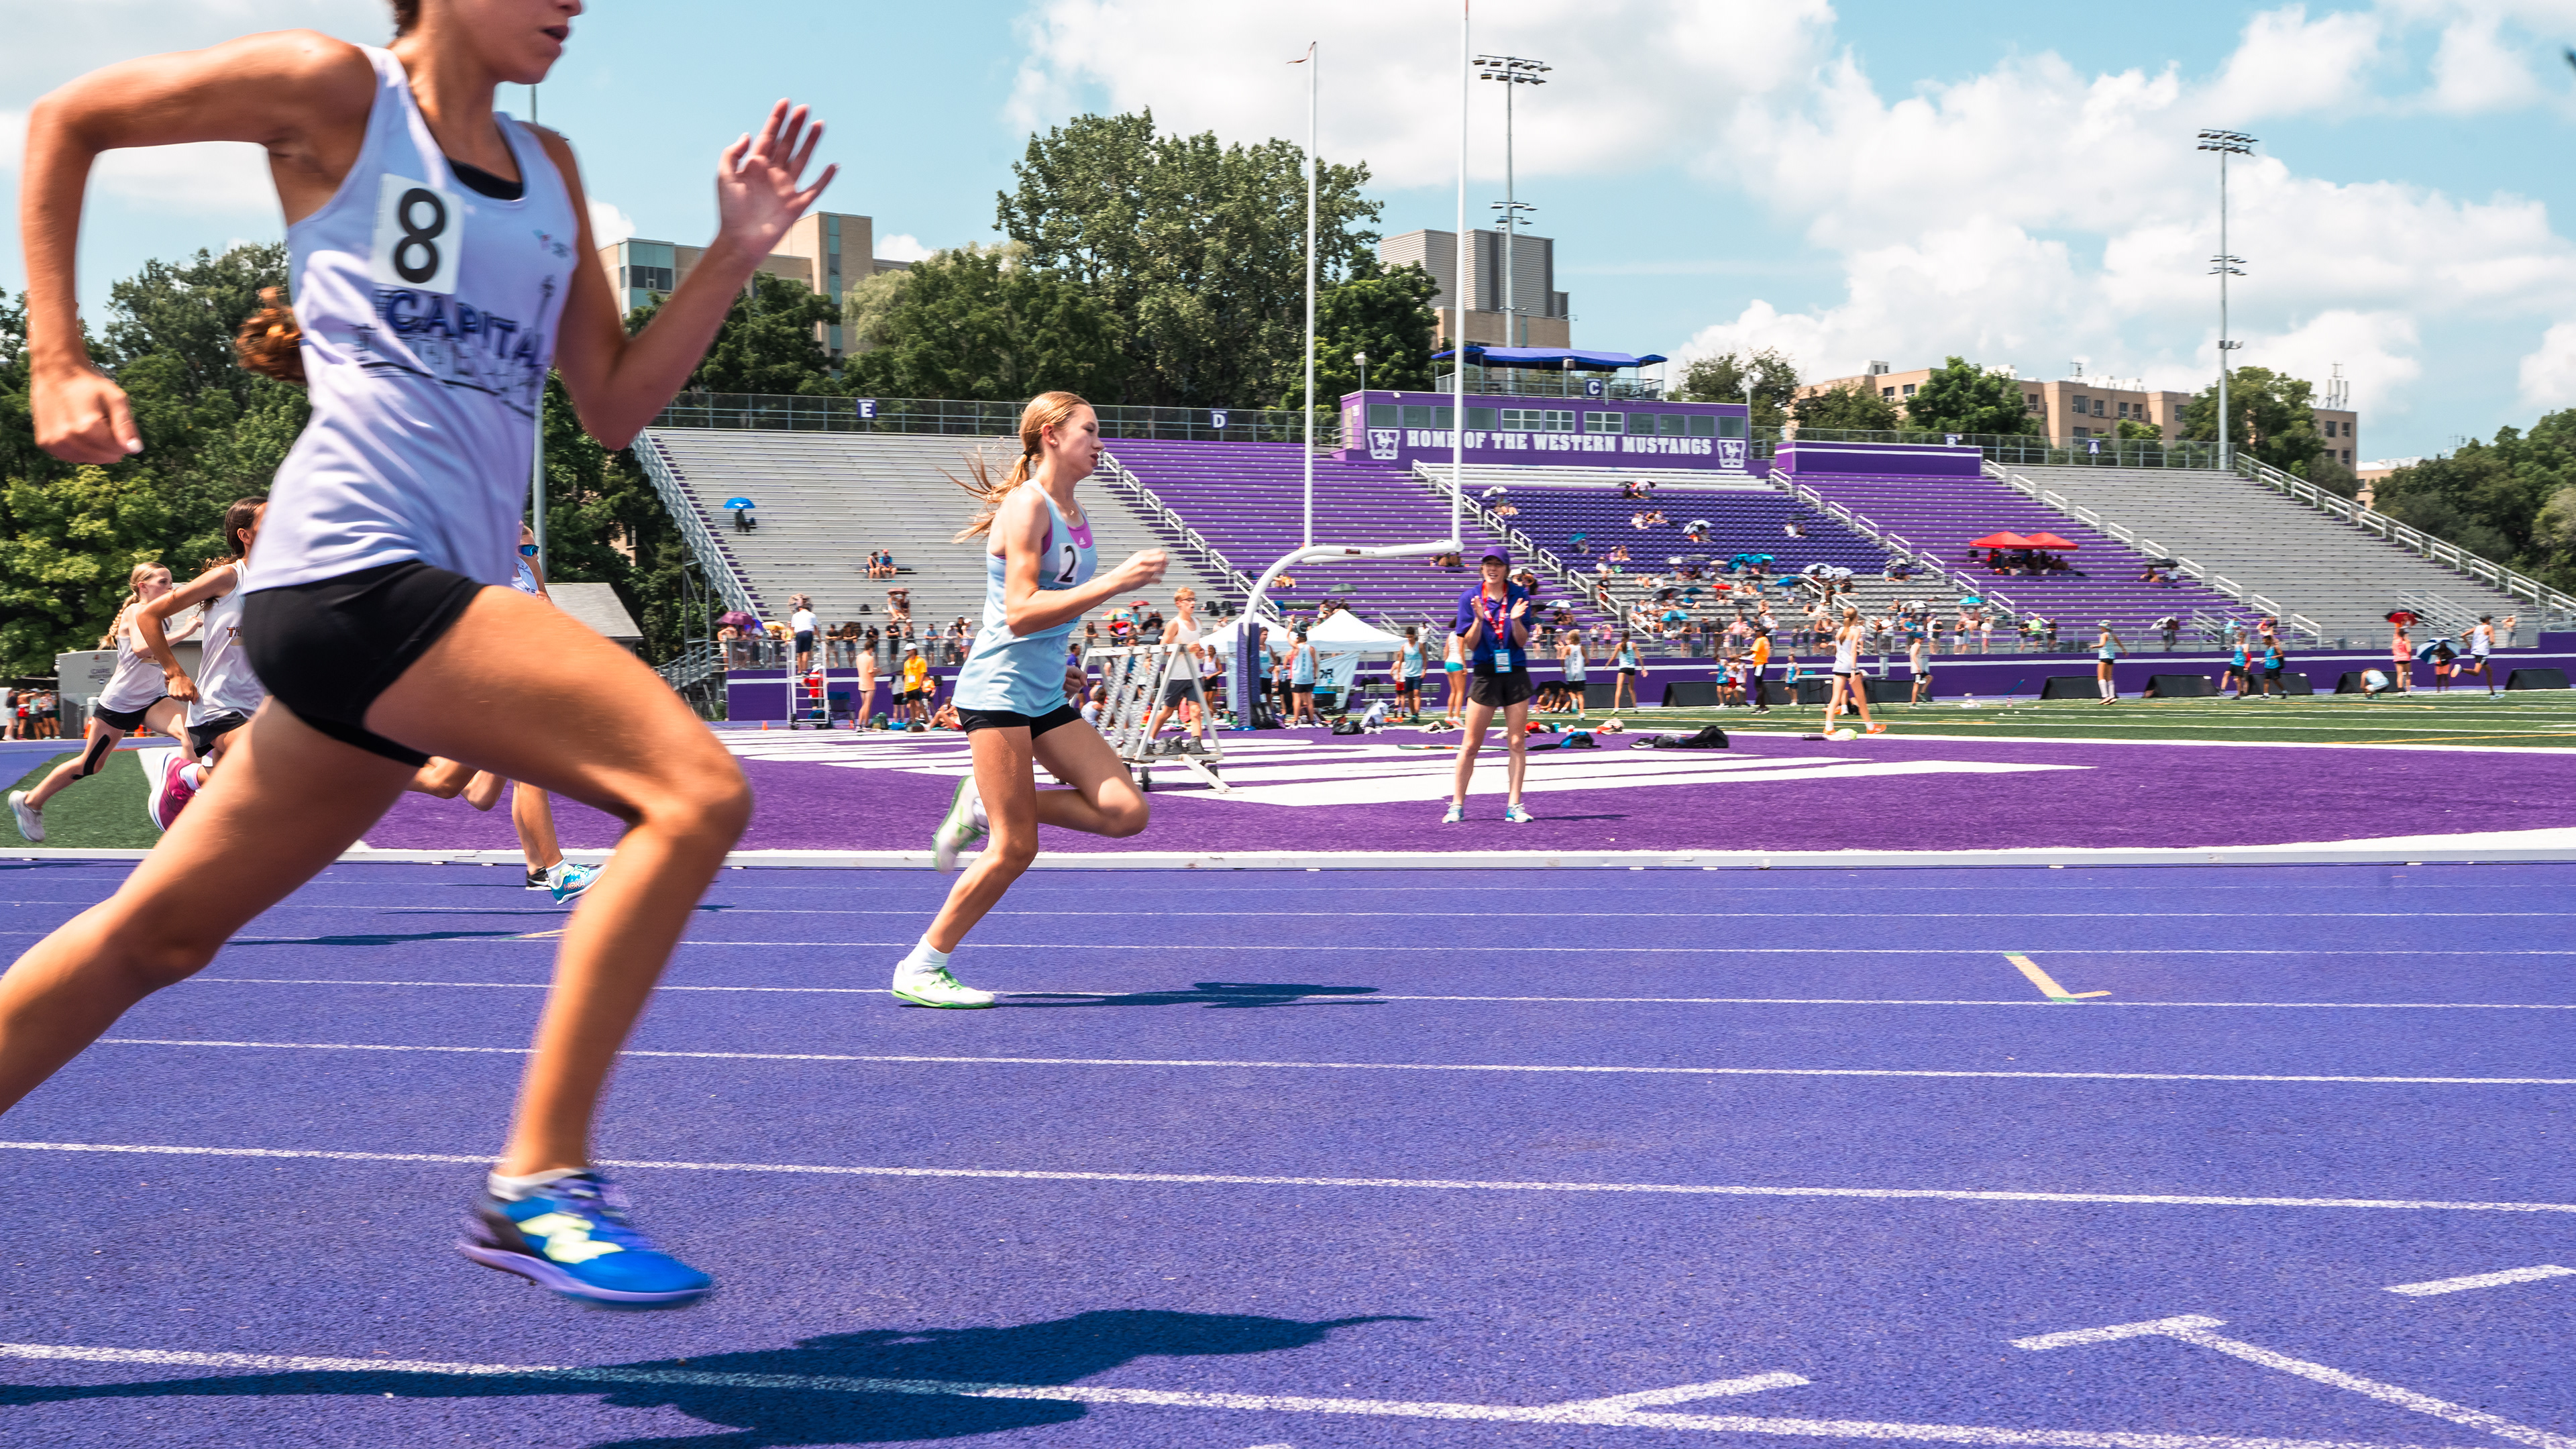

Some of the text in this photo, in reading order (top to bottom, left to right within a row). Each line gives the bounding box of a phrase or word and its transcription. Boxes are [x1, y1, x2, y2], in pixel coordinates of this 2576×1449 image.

[394, 187, 446, 284] 8
[1588, 381, 1600, 395] C
[861, 402, 873, 418] E
[1212, 414, 1226, 428] D
[1407, 430, 1712, 455] HOME OF THE WESTERN MUSTANGS
[1946, 437, 1957, 448] B
[2088, 442, 2100, 454] A
[1059, 545, 1076, 584] 2
[564, 879, 586, 892] HOKA
